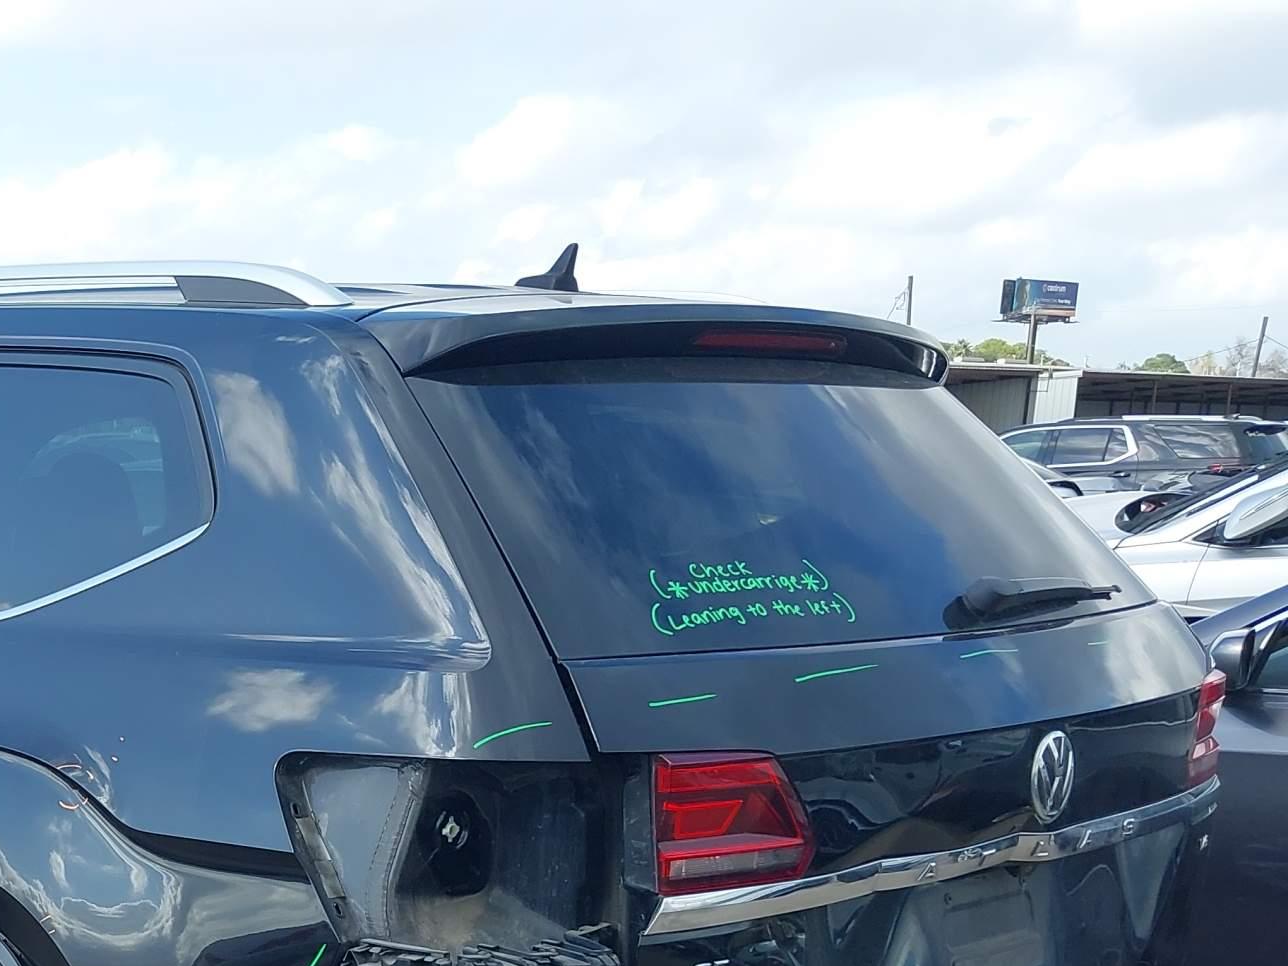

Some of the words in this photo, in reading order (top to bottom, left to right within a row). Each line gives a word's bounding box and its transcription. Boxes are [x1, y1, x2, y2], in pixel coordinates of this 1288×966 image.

[689, 560, 752, 579] Check
[746, 603, 768, 617] to
[773, 599, 805, 616] the
[916, 816, 1137, 881] ATLAS
